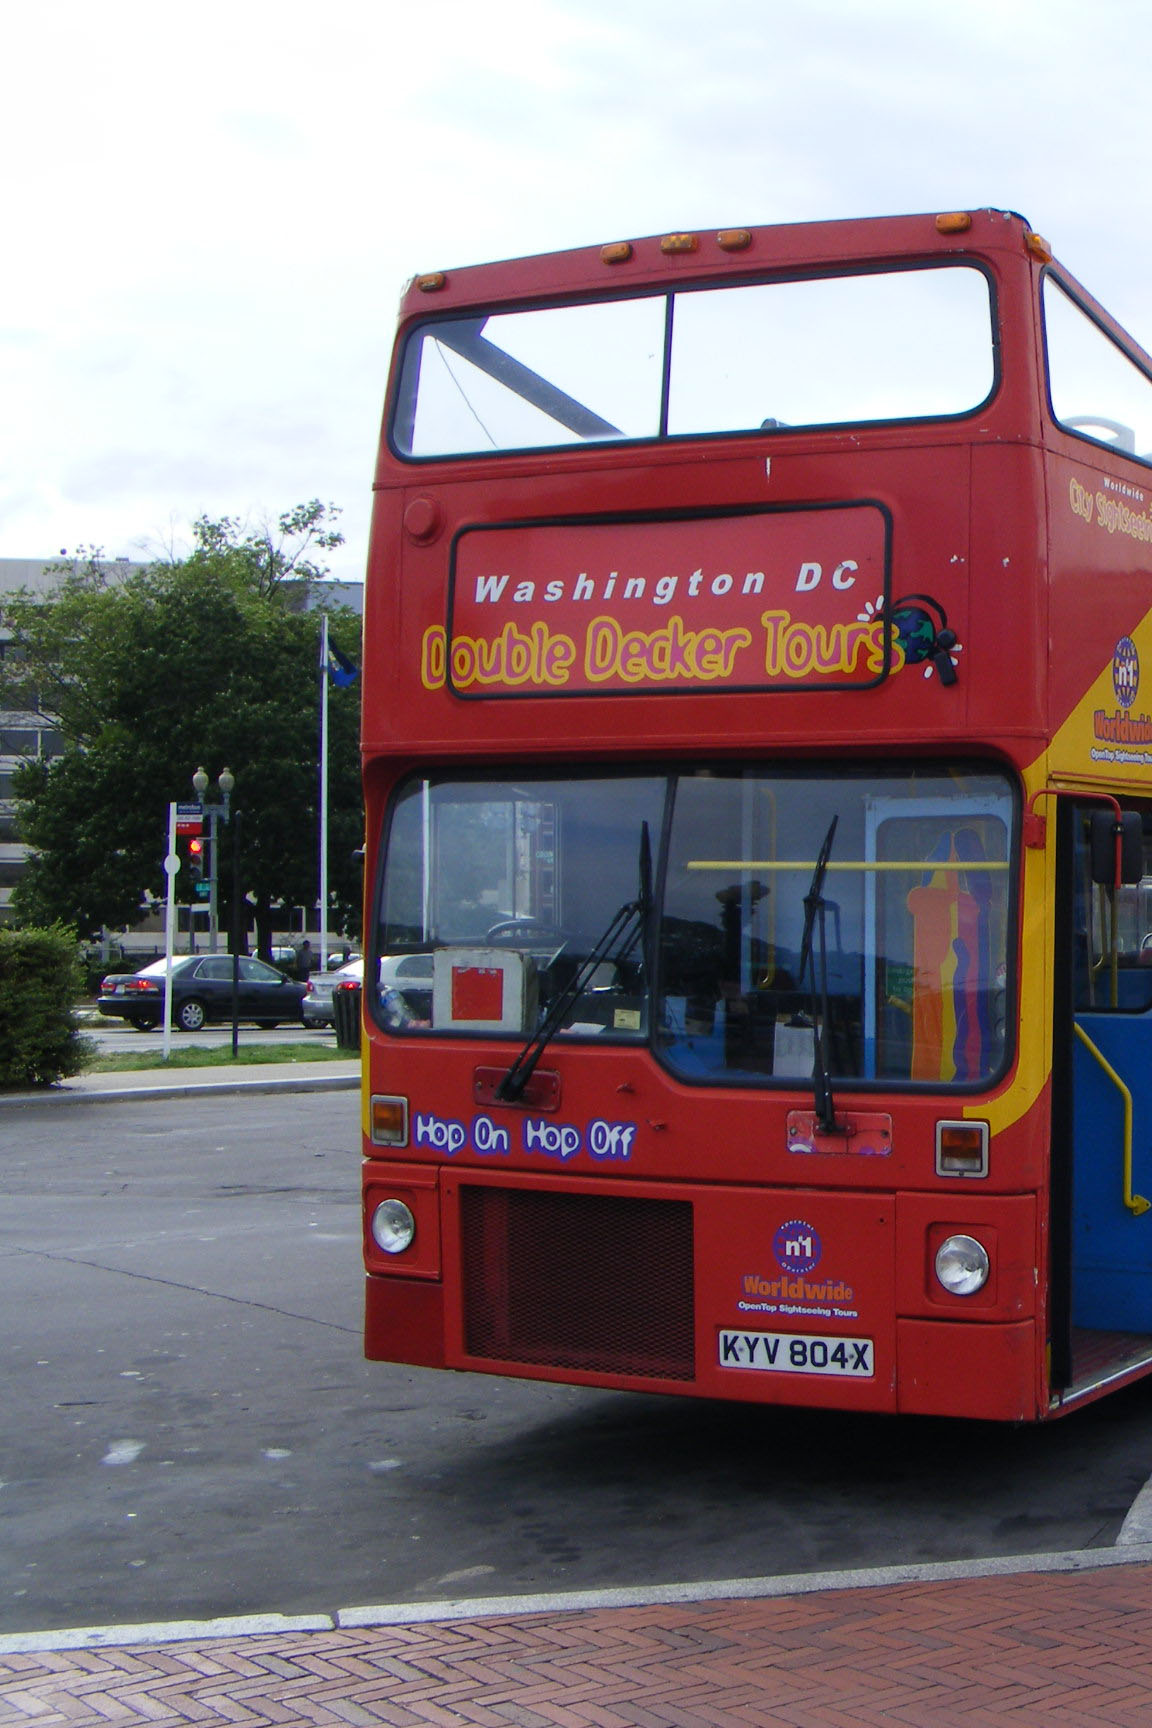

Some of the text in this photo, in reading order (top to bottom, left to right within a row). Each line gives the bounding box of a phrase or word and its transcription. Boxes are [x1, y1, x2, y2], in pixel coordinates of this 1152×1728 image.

[1070, 478, 1093, 522] City
[1103, 477, 1144, 501] Worldwide
[475, 560, 858, 605] Washington DC
[421, 610, 906, 689] Double Decker Tours
[416, 1115, 635, 1156] Hop On Hop Off
[743, 1275, 853, 1300] Worldwide
[738, 1300, 858, 1317] OpenTop Sightseeing Tours
[723, 1335, 869, 1370] KYV 804X
